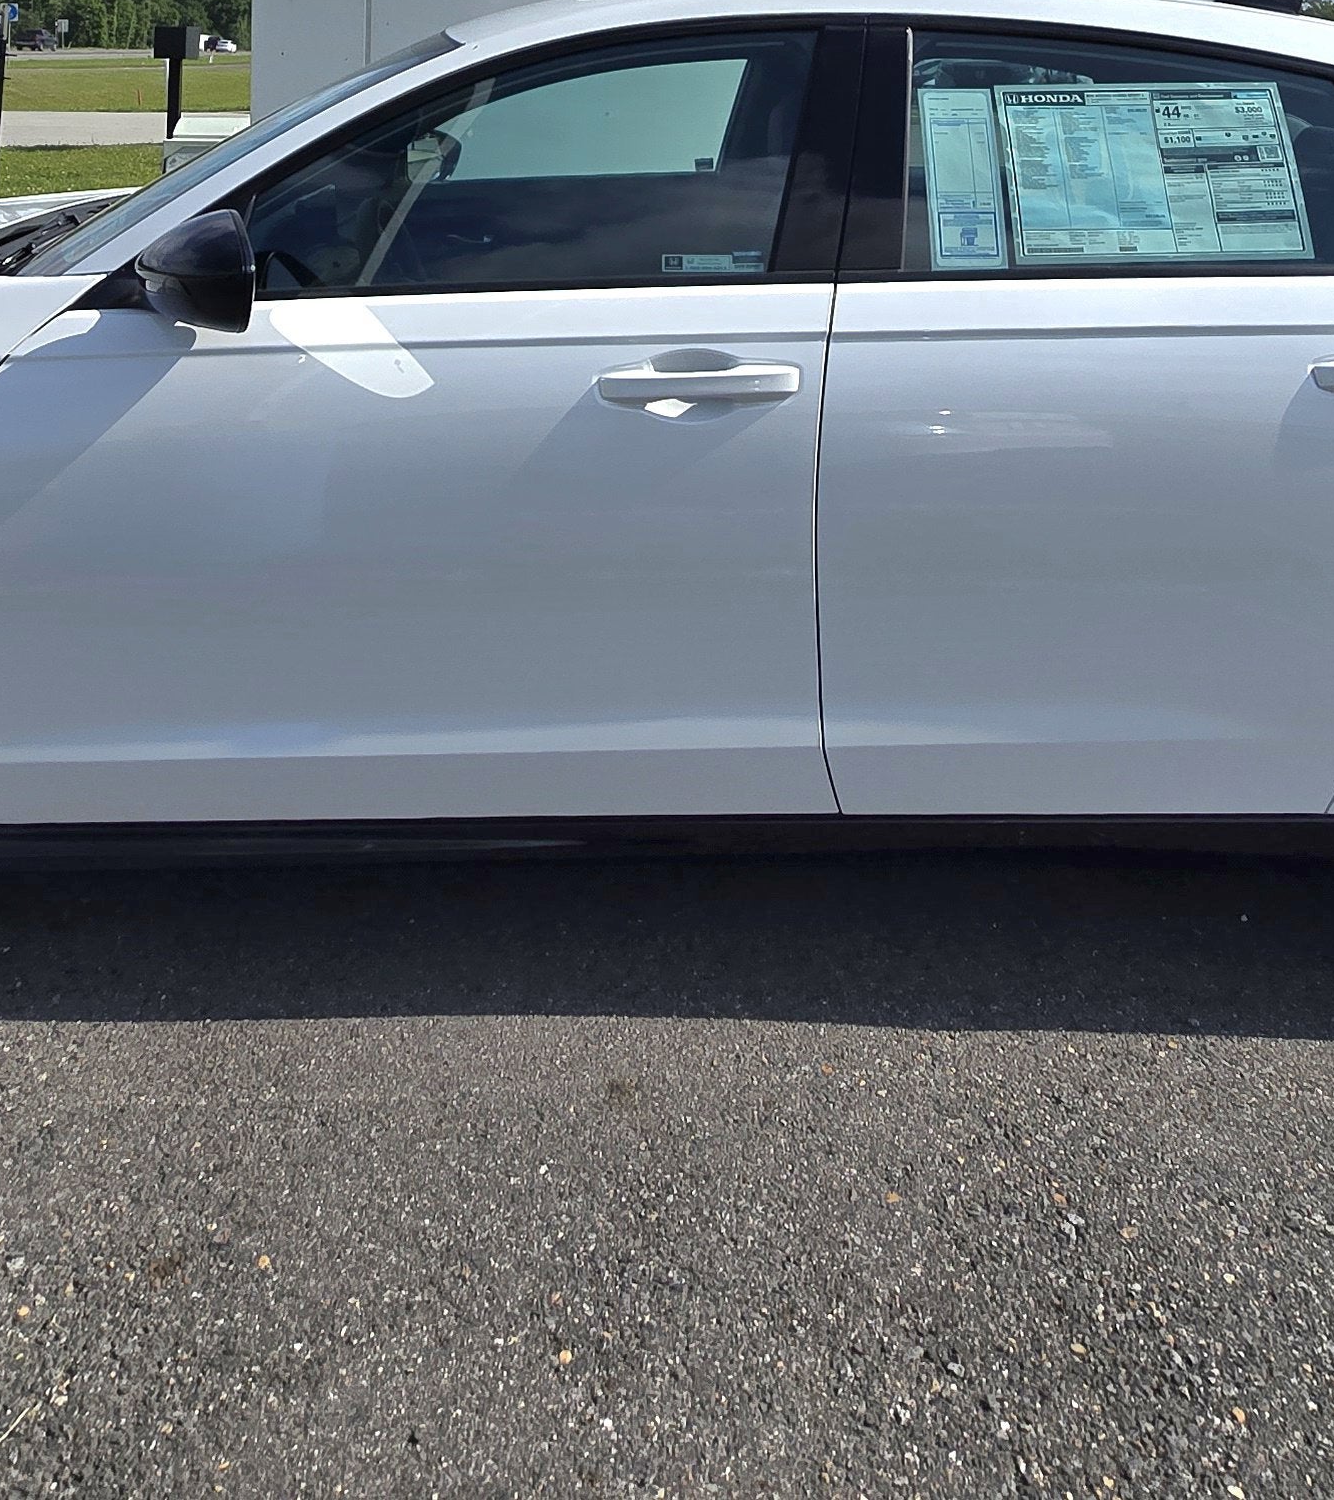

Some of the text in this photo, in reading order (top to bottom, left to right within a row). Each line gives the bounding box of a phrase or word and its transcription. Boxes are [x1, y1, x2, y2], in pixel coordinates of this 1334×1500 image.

[1020, 94, 1084, 103] HONDA
[1162, 105, 1182, 119] 44
[1234, 106, 1264, 115] $3,000
[1163, 135, 1192, 145] $1,100
